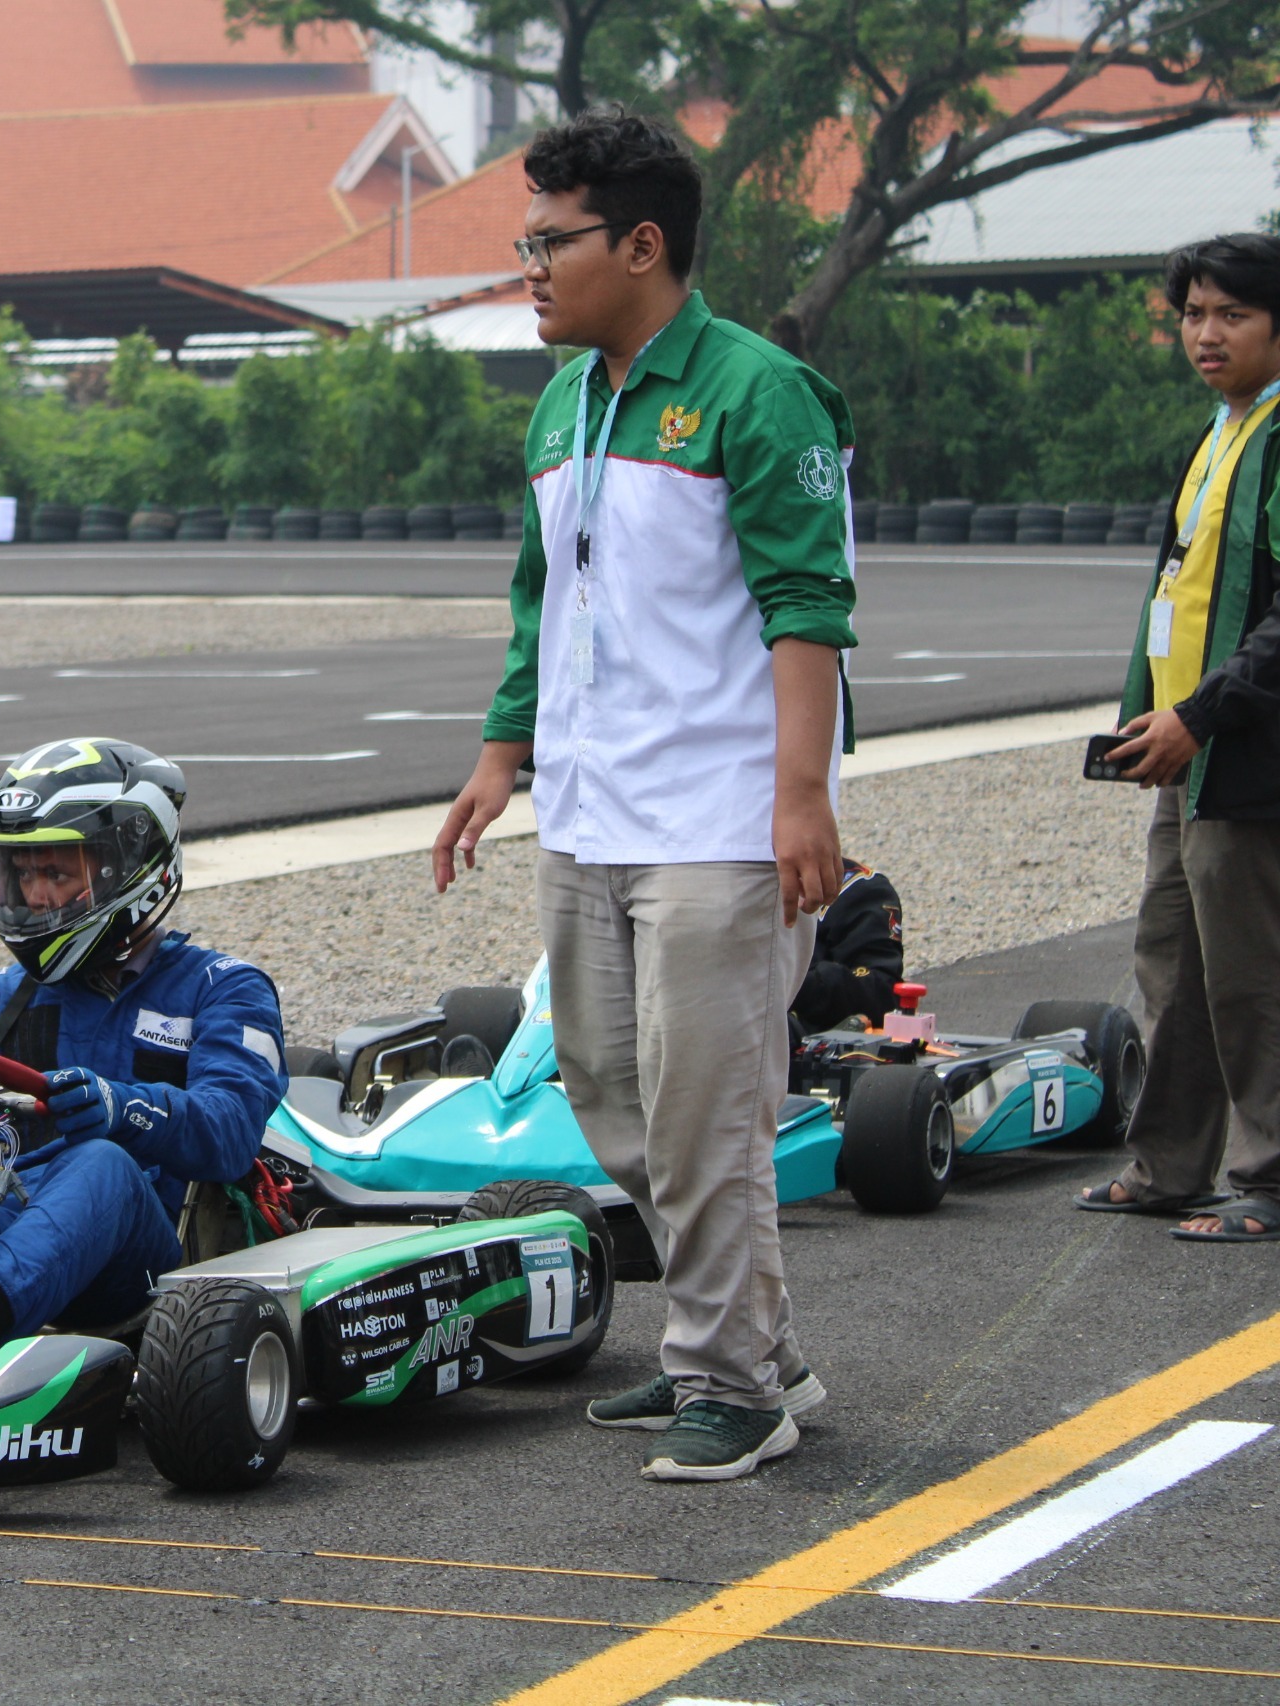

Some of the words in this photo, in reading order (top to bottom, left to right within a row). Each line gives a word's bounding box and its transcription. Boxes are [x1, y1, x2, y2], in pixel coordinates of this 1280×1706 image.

[1044, 1082, 1056, 1126] 6
[430, 1267, 445, 1279] PLN
[468, 1267, 480, 1277] PLN
[337, 1282, 415, 1311] rapidHARNESS
[439, 1298, 459, 1313] PLN
[546, 1275, 556, 1330] 1
[361, 1345, 388, 1360] WILSON
[388, 1337, 410, 1352] CABLES
[408, 1314, 475, 1370] ANR
